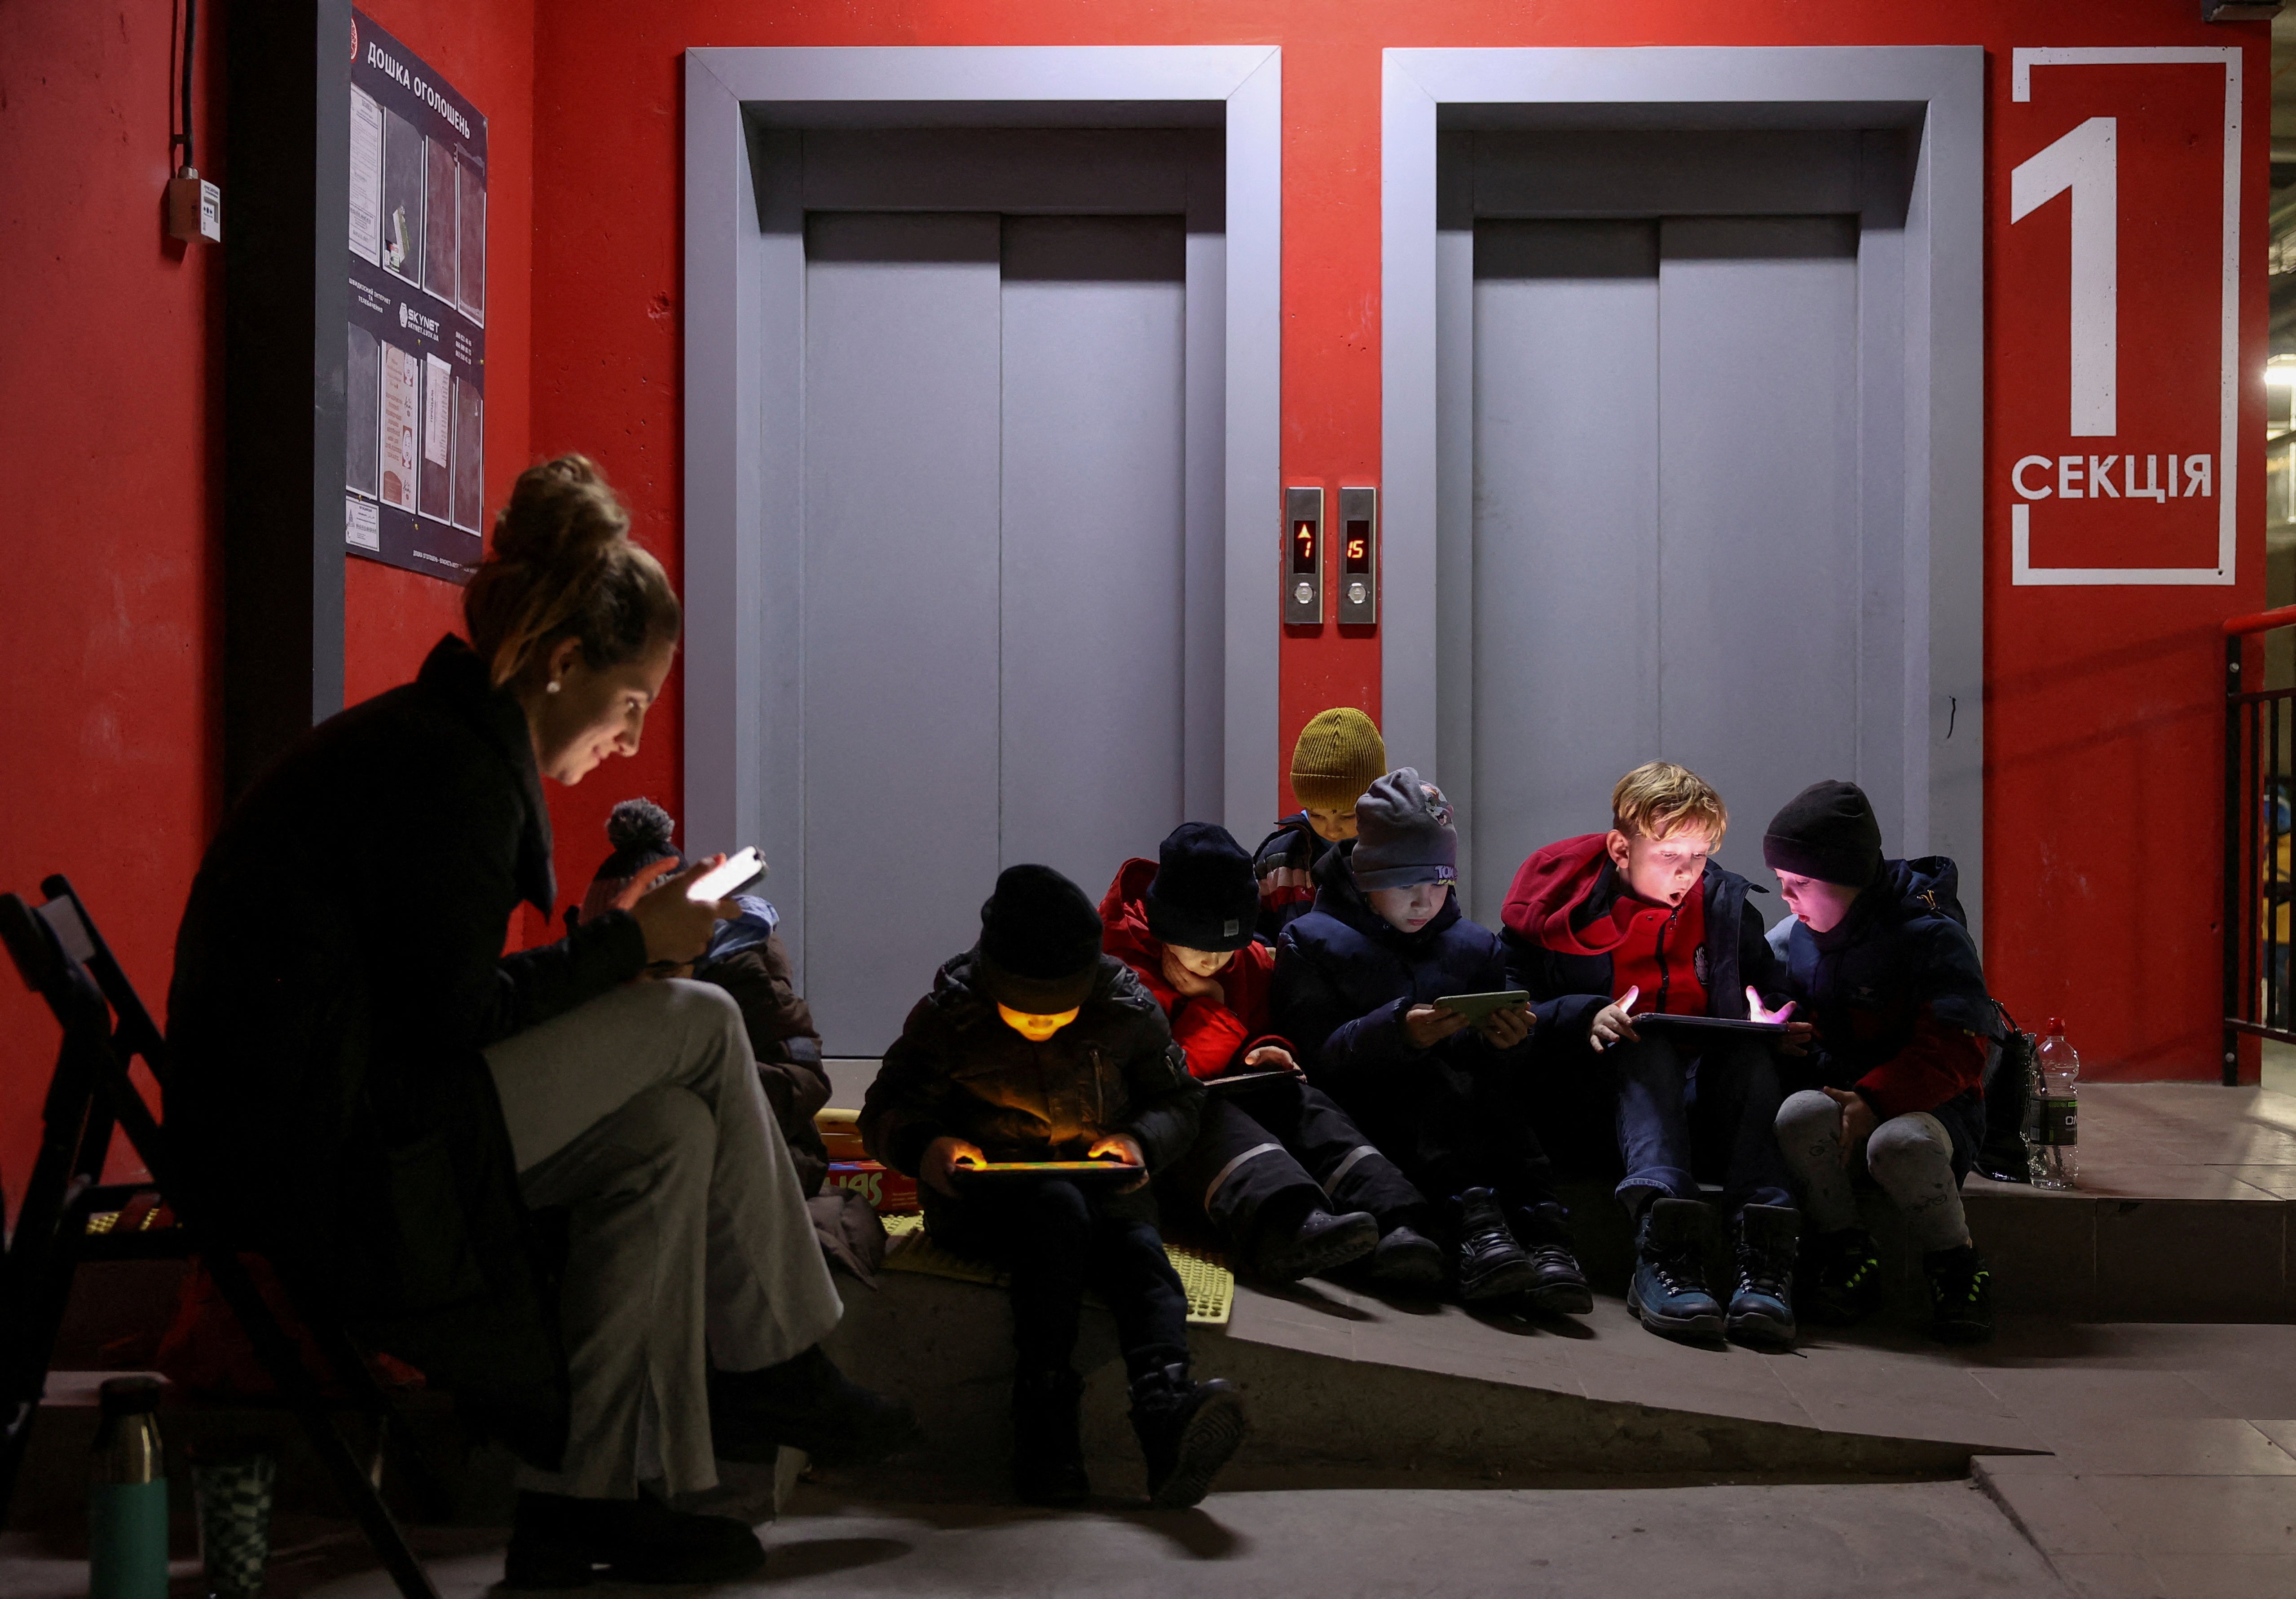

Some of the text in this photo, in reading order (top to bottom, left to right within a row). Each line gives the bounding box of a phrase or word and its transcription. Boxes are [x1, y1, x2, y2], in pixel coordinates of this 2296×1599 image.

[368, 42, 471, 139] ДОШКА ОГОЛОШЕНЬ
[2011, 117, 2116, 436] 1
[408, 309, 440, 333] SKYNET
[408, 321, 439, 342] SKYNET.LVIV.UA
[2011, 454, 2212, 504] СЕКЦІЯ
[1305, 541, 1311, 558] 1
[1347, 540, 1364, 558] 15
